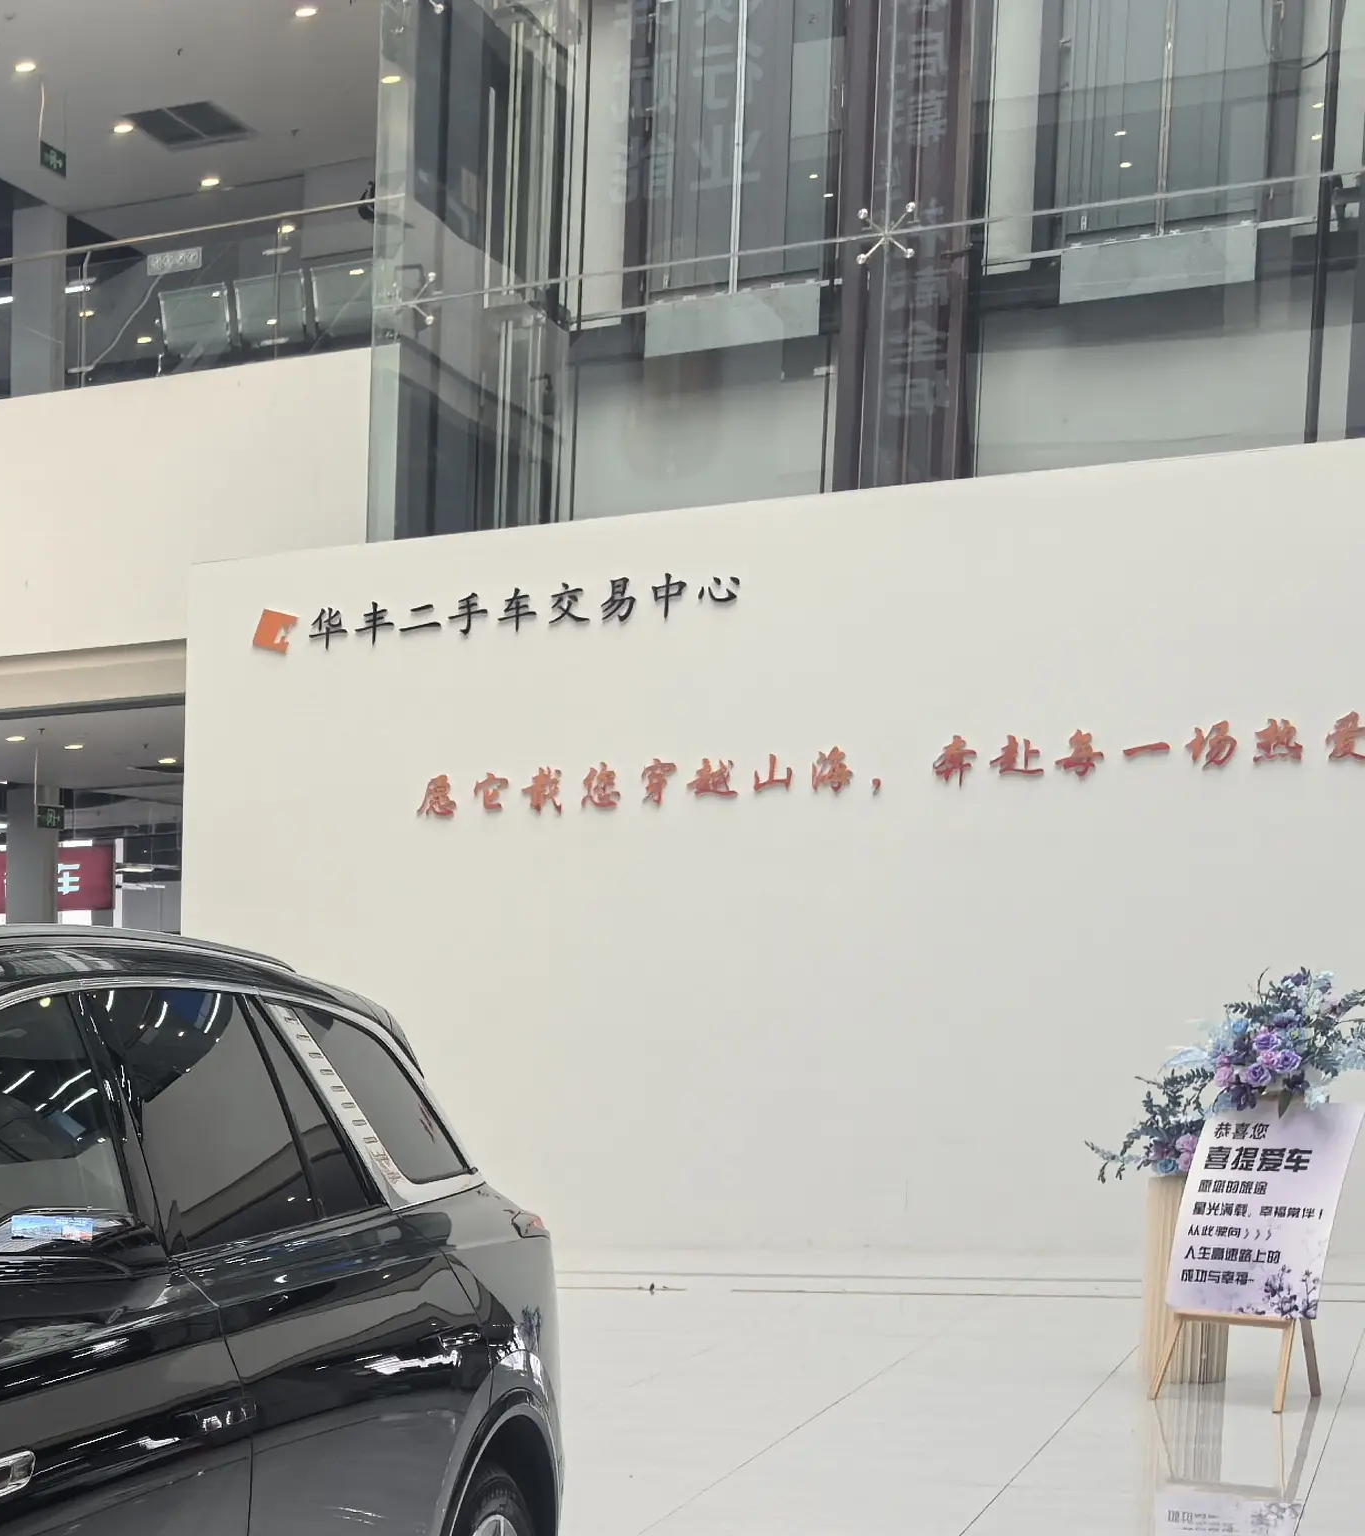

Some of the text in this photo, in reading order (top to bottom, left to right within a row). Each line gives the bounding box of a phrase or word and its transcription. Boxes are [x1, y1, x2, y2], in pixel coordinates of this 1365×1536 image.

[309, 573, 740, 651] 华丰二手车交易中心
[1214, 1122, 1270, 1140] 恭喜您
[1204, 1146, 1312, 1172] 喜提爱车
[1184, 1245, 1281, 1264] 人生高速路上的
